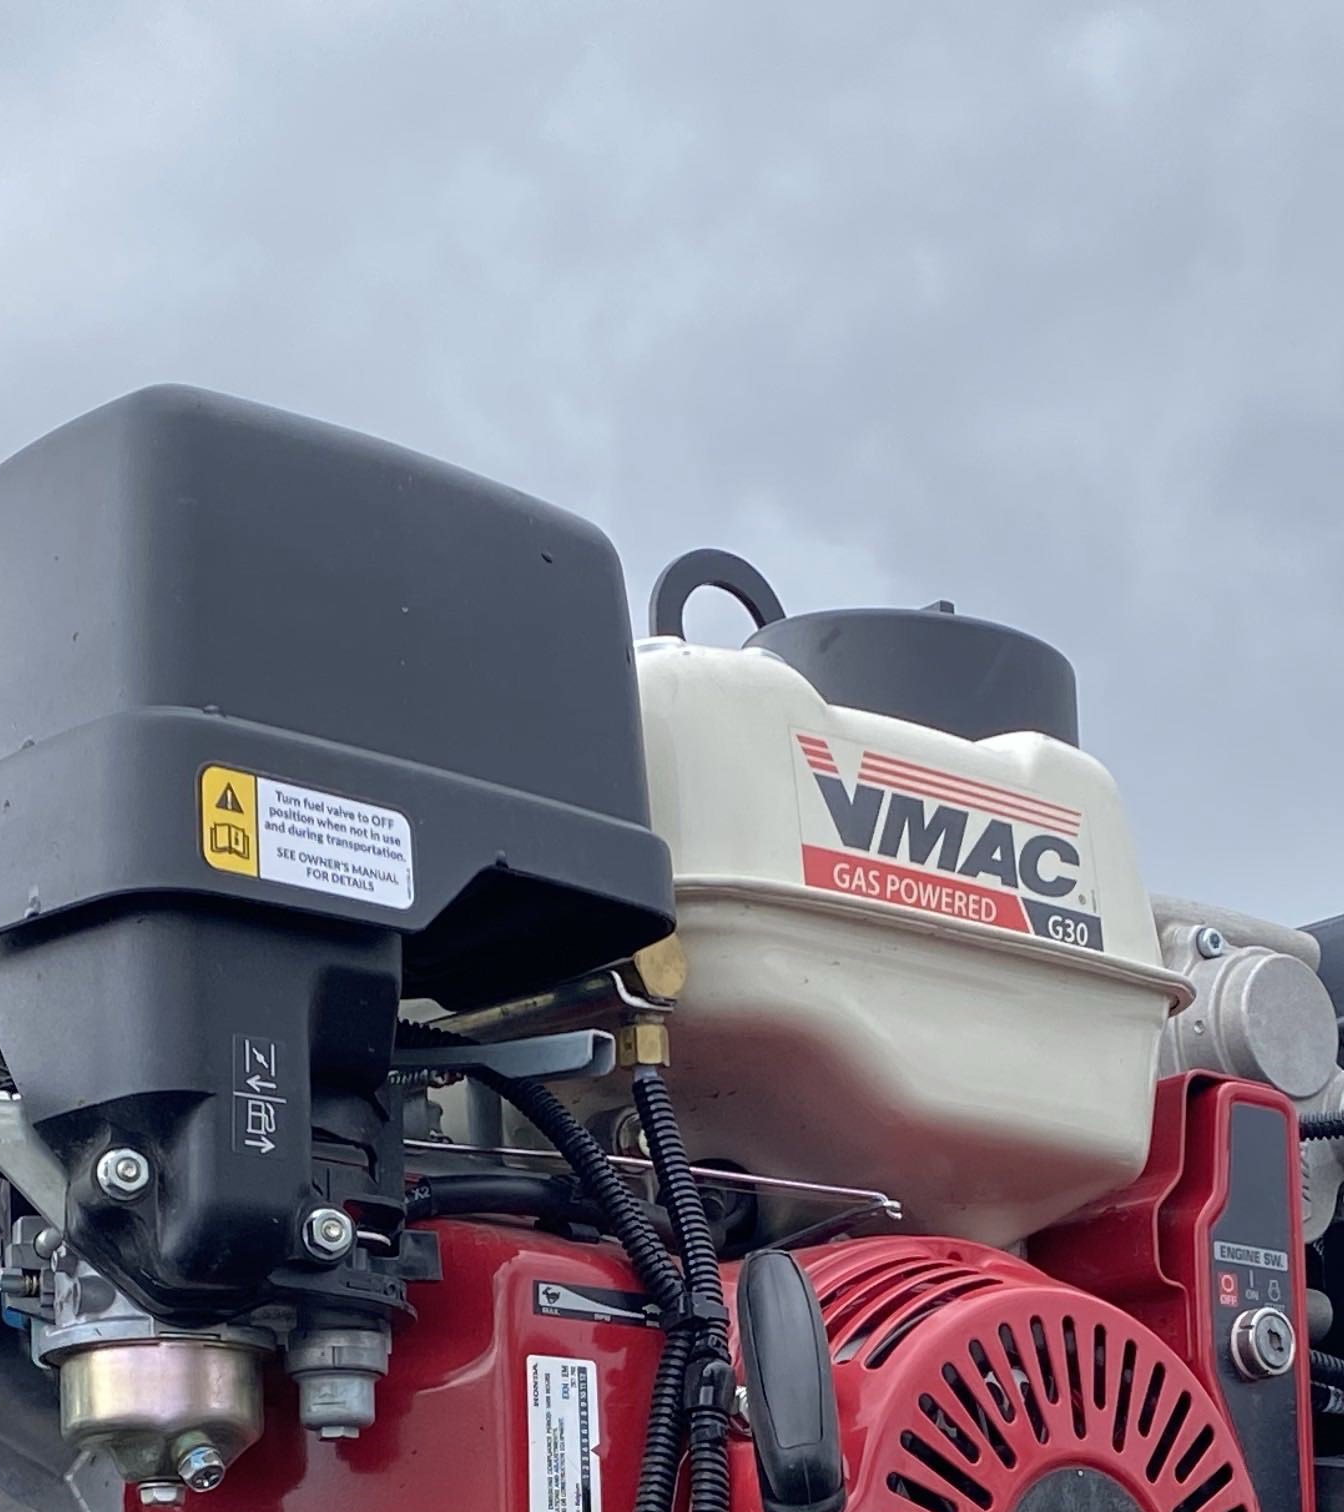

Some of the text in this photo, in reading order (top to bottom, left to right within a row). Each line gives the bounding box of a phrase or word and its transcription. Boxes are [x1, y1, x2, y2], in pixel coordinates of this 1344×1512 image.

[269, 806, 400, 847] position when not in use
[276, 790, 393, 829] Turn fuel valve to OFF
[264, 820, 406, 862] and during transportation.
[810, 765, 1080, 897] VMAC
[277, 847, 296, 861] SEE
[299, 853, 349, 872] OWNER'S
[352, 865, 399, 884] MANUAL
[307, 869, 374, 892] FOR DETAILS
[833, 863, 997, 922] GAS POWERED
[1048, 915, 1088, 946] G30
[1220, 1245, 1284, 1267] ENGINE SW.
[1220, 1295, 1237, 1305] OFF
